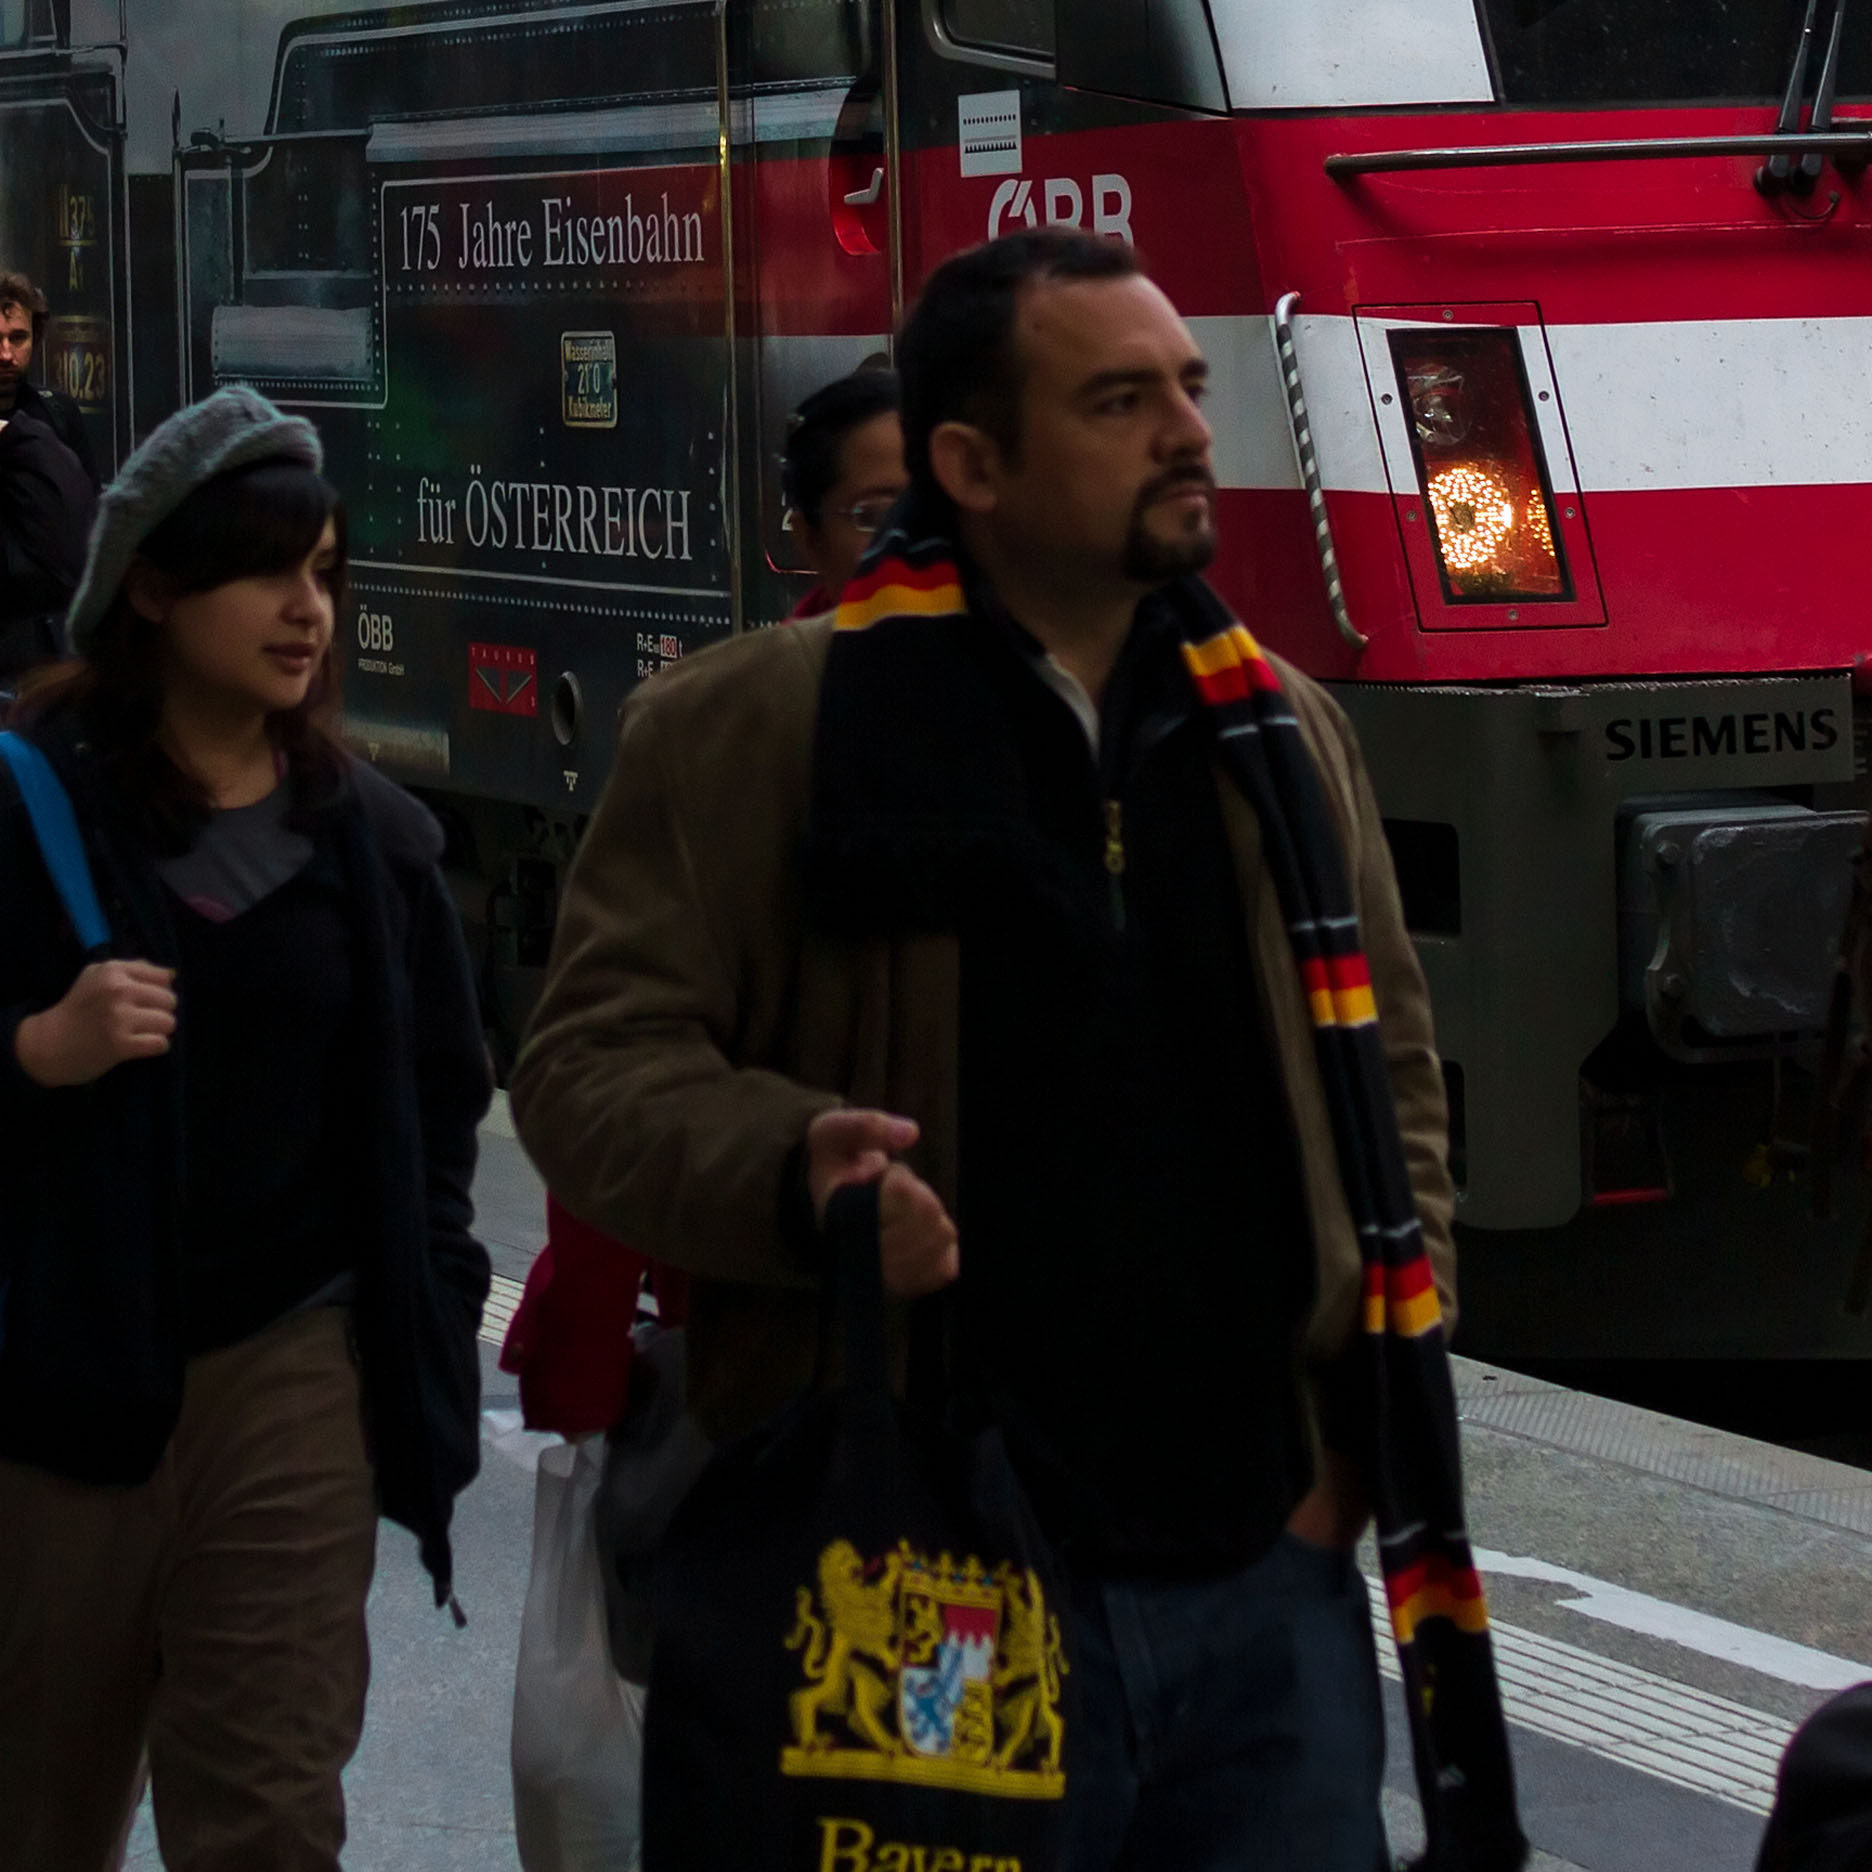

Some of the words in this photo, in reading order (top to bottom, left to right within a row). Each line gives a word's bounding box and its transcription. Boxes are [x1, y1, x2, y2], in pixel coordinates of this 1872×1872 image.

[400, 202, 442, 271] 175
[458, 200, 533, 269] Jahre
[541, 192, 705, 266] Eisenbahn
[417, 477, 456, 544] für
[465, 464, 693, 561] ÖSTERREICH
[357, 604, 394, 652] ÖBB
[1605, 708, 1837, 761] SIEMENS
